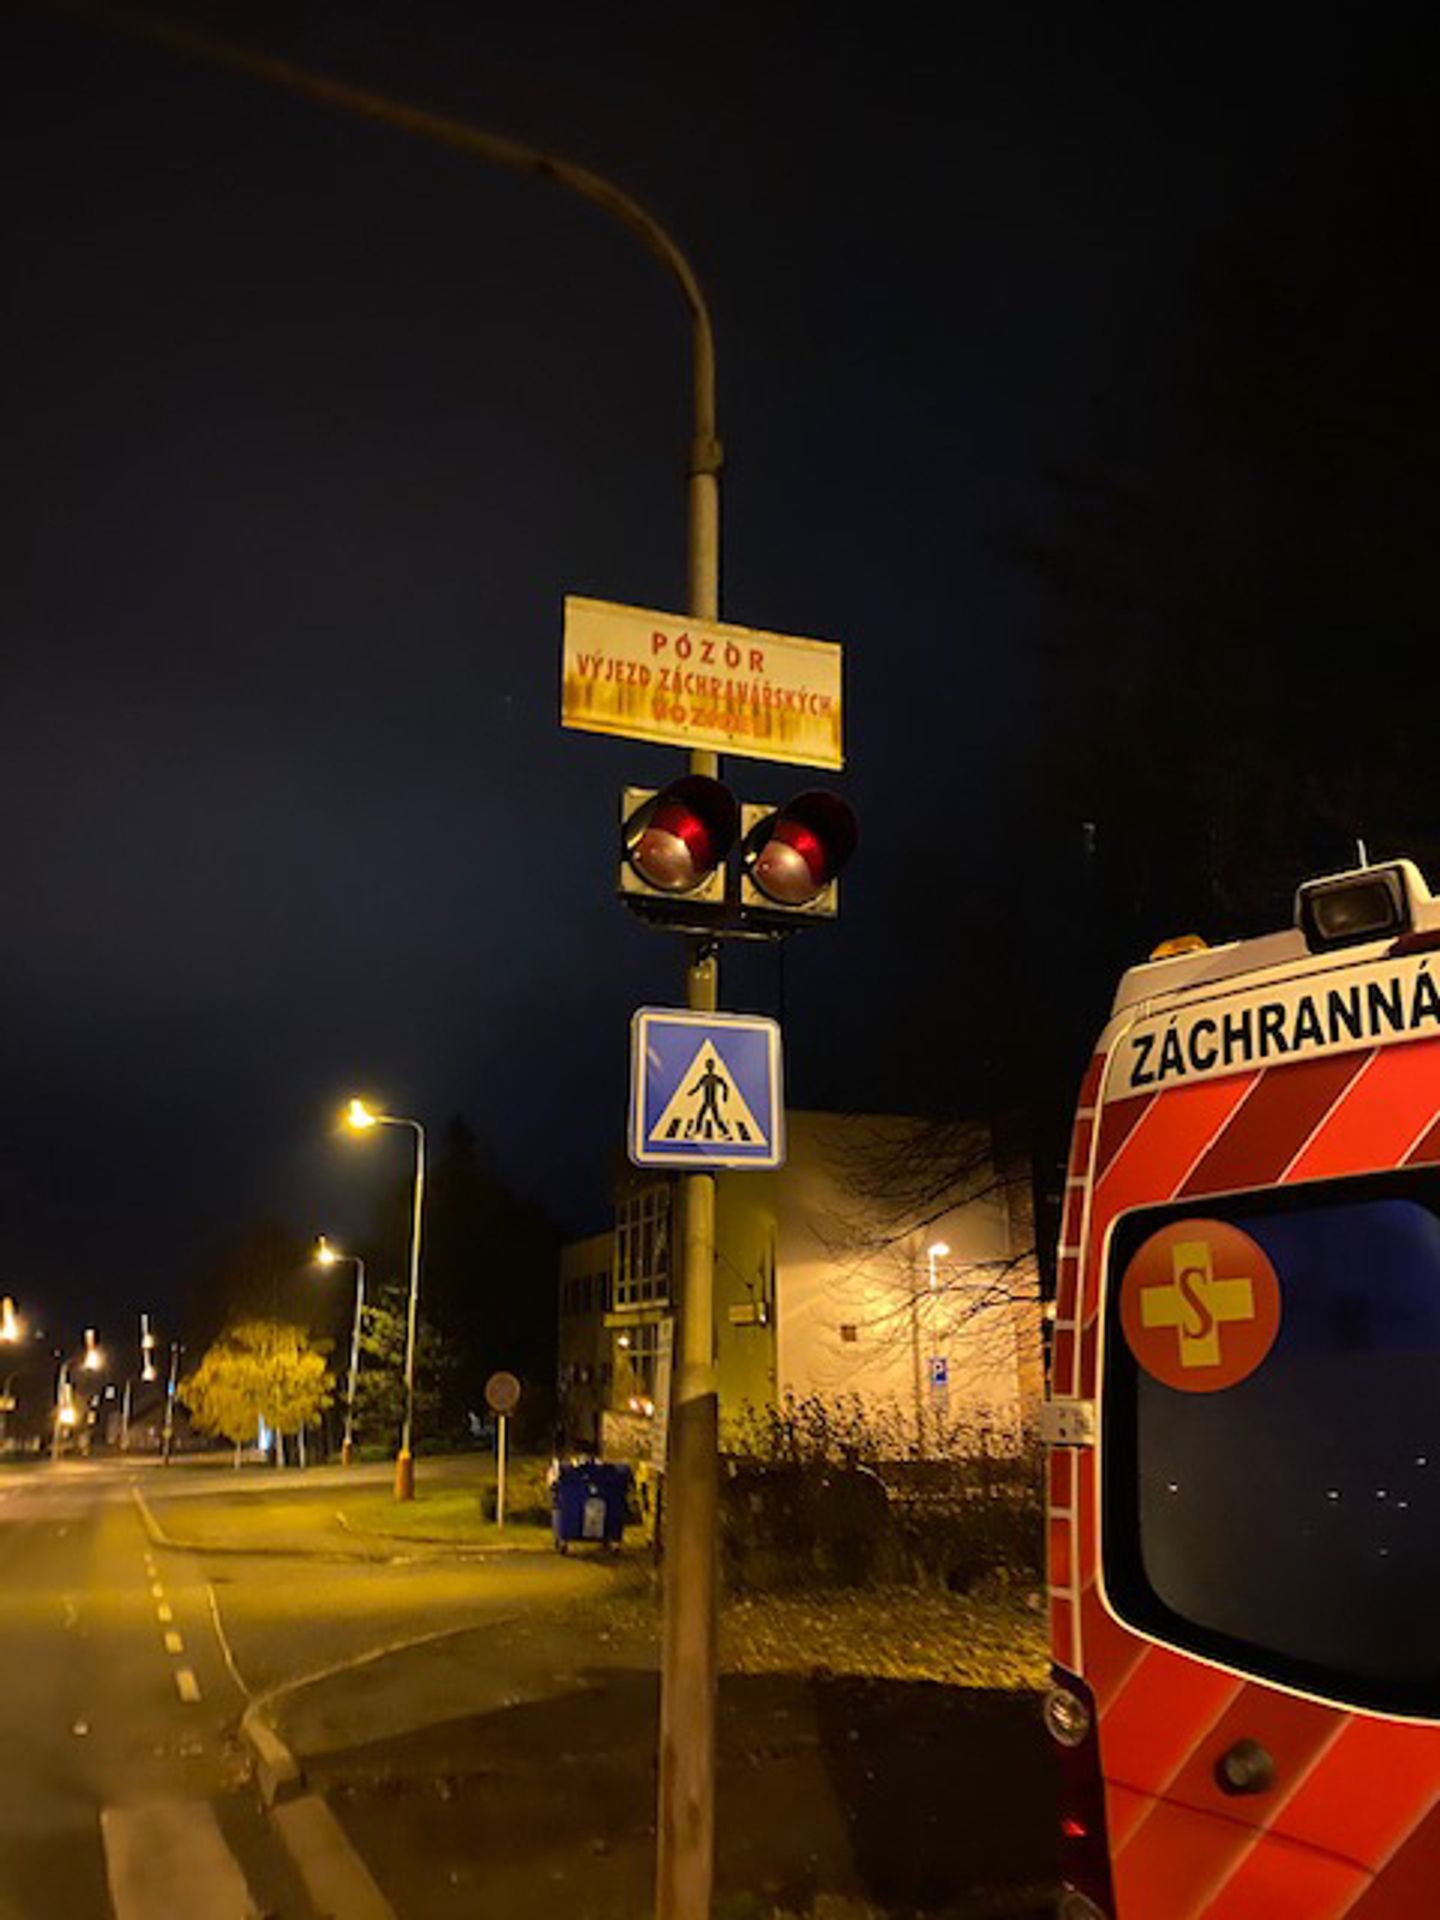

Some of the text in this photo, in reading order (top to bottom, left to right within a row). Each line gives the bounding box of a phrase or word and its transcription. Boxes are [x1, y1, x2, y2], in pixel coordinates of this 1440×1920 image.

[576, 650, 651, 686] VÝJEZD
[1130, 958, 1440, 1088] ZÁCHRANNÁ
[1180, 1267, 1214, 1339] S
